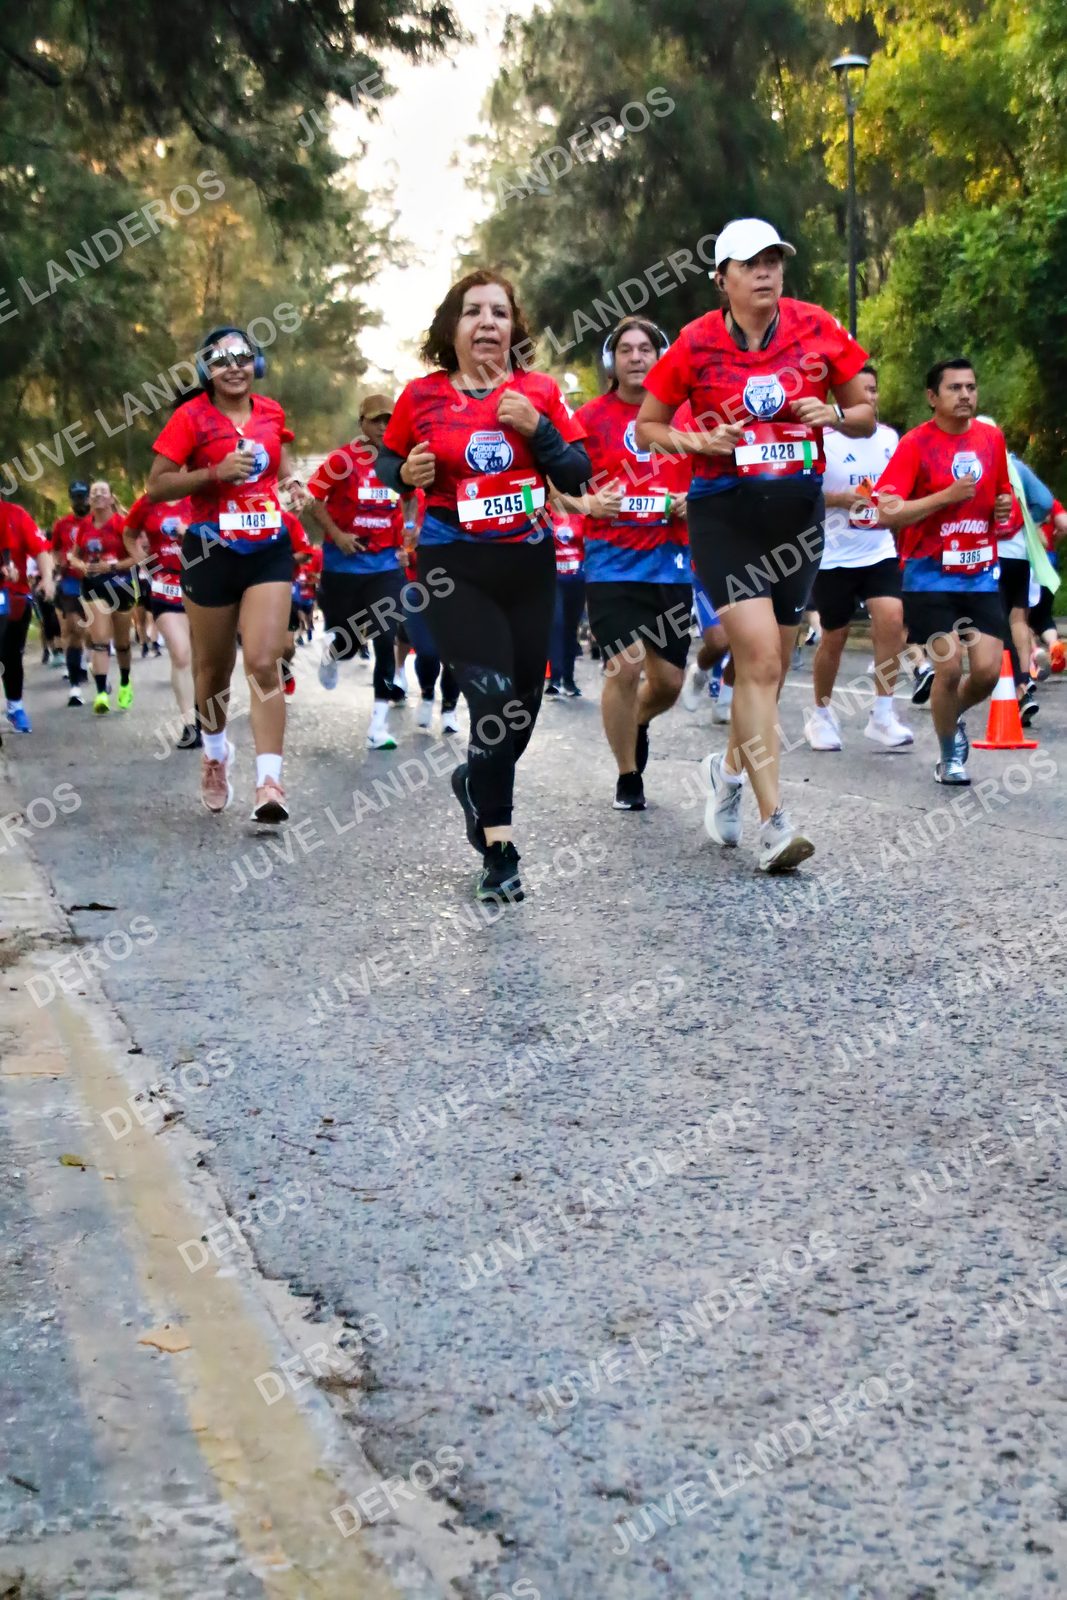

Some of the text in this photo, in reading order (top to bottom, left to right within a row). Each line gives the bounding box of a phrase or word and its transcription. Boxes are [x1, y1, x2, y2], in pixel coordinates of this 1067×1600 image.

[761, 444, 796, 461] 2428
[484, 494, 523, 517] 2545
[628, 498, 656, 511] 2977
[240, 514, 266, 528] 1489
[960, 550, 981, 564] 3365
